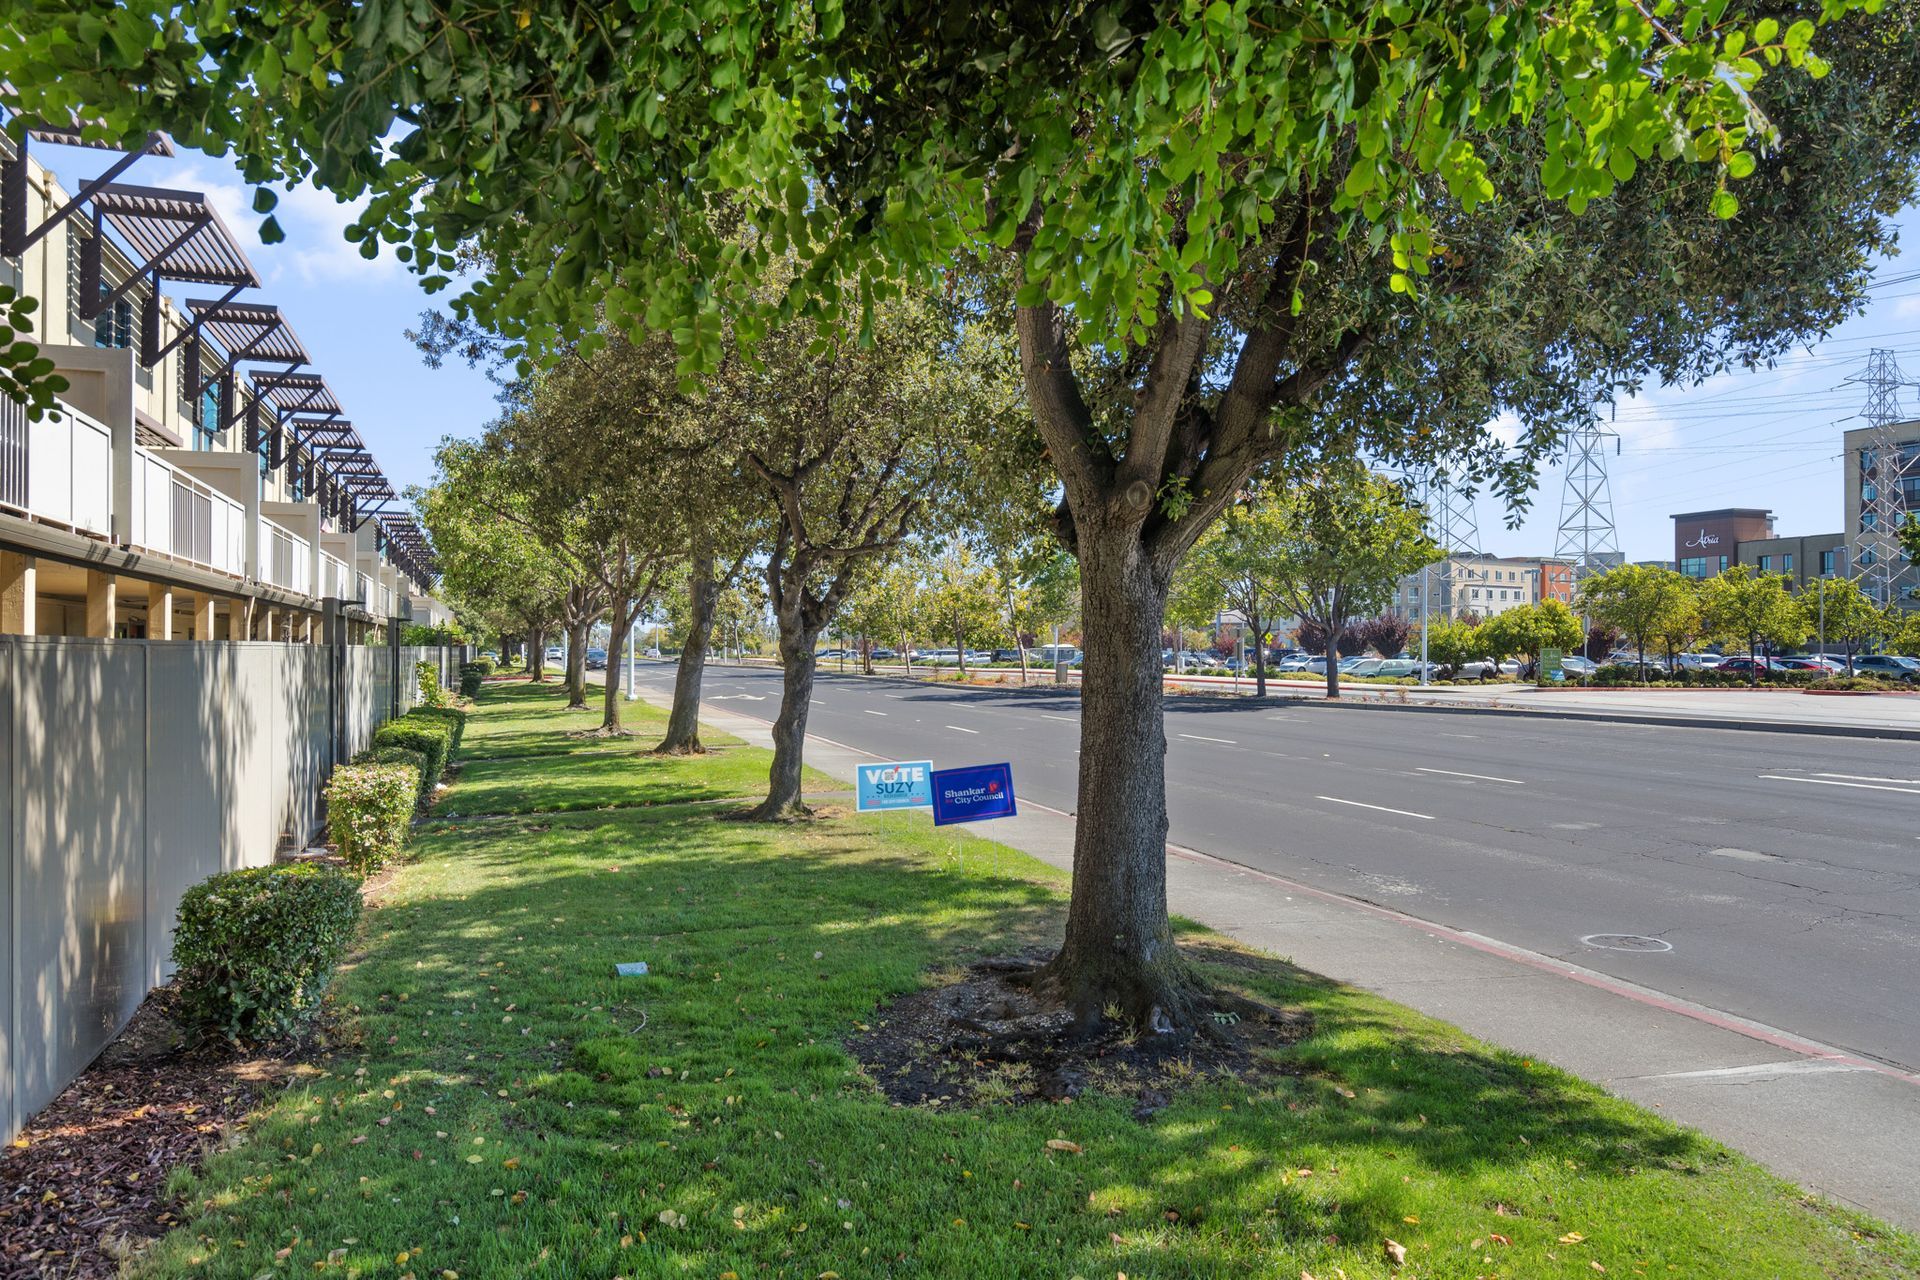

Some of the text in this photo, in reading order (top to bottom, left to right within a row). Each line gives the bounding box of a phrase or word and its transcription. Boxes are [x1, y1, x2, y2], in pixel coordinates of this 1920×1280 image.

[866, 767, 924, 784] VOTE
[876, 782, 914, 794] SUZY
[945, 787, 986, 798] Shankar
[973, 792, 1004, 801] Council
